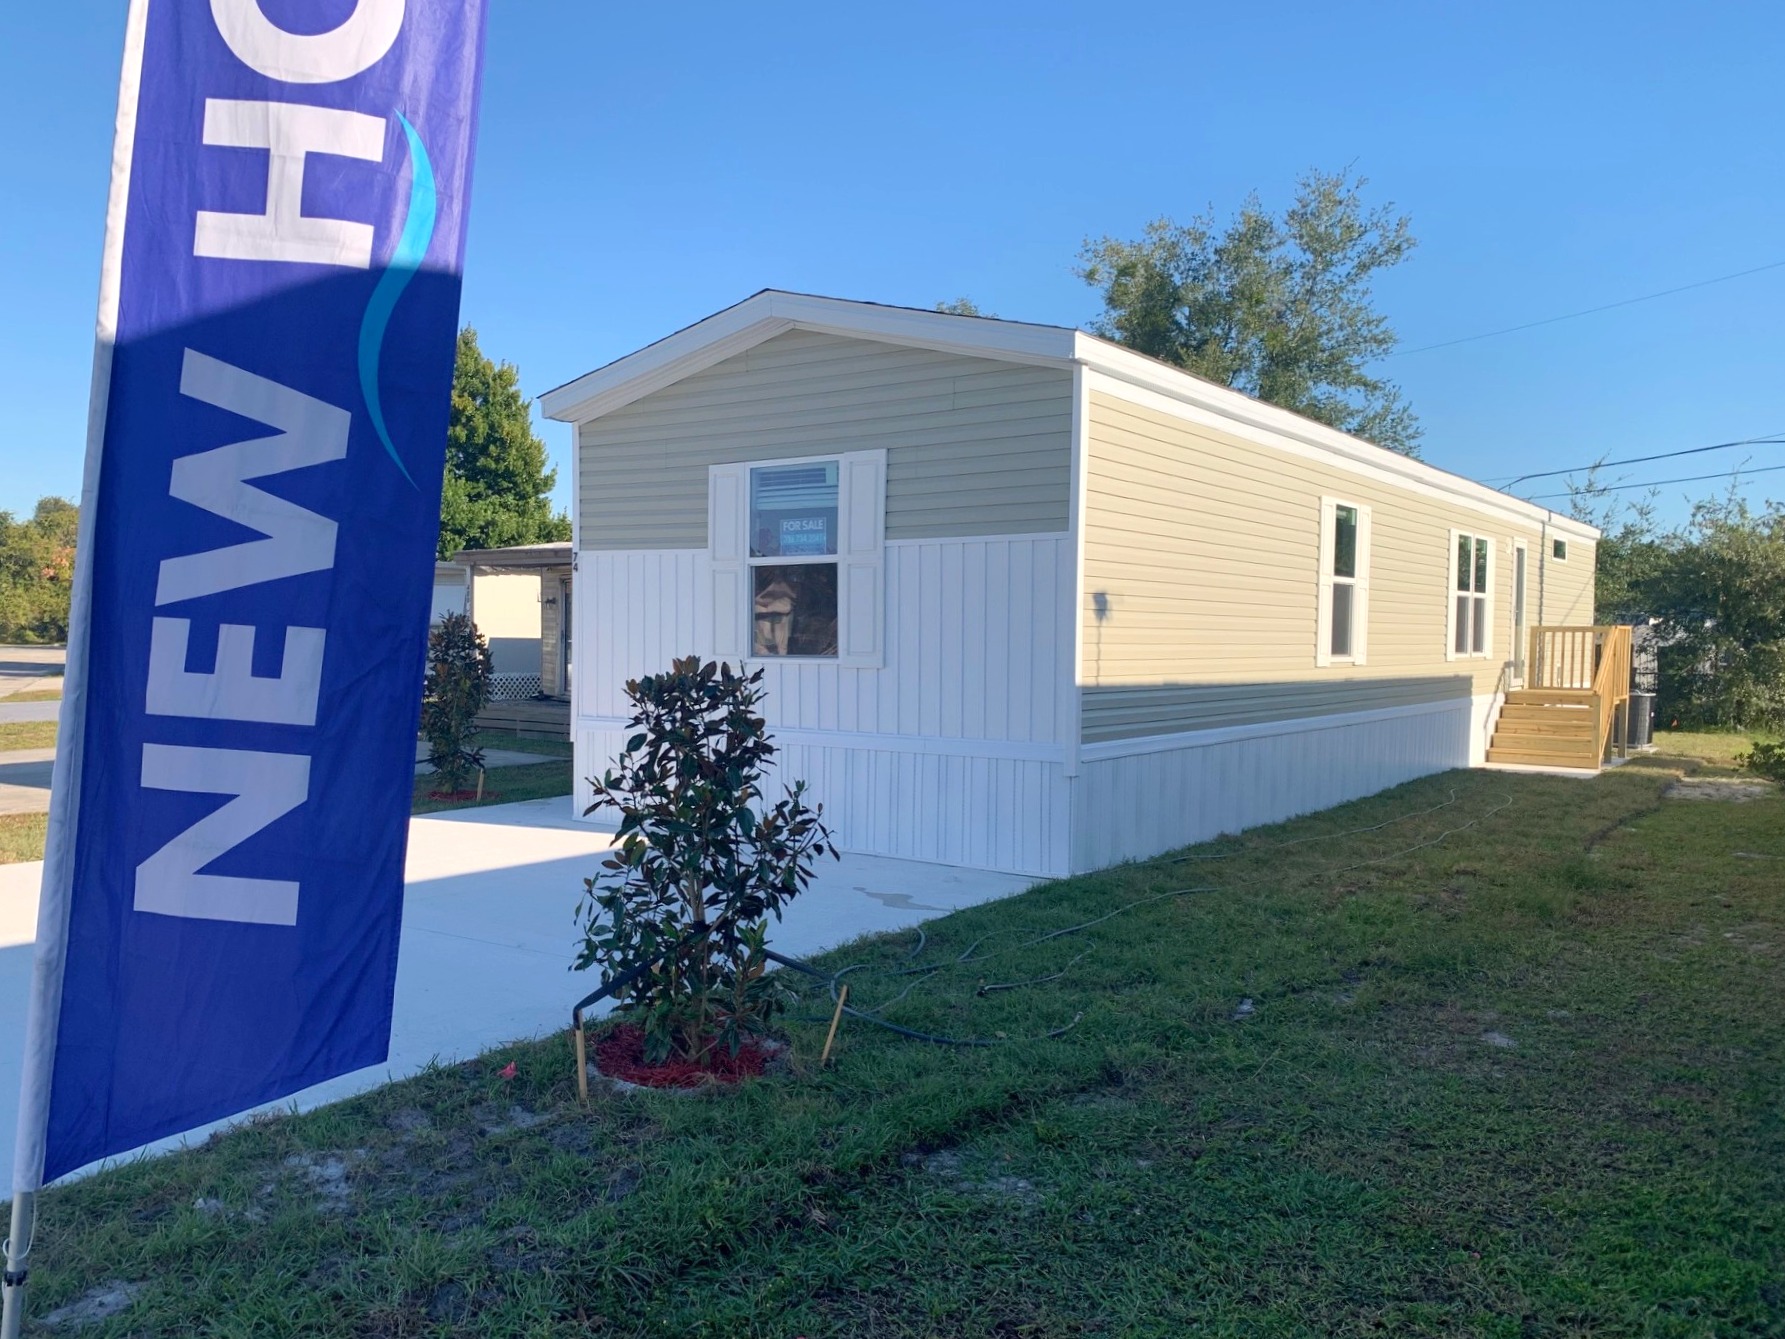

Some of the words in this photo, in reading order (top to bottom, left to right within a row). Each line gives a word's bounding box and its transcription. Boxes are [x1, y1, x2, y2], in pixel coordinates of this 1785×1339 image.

[134, 347, 352, 926] NEW
[783, 521, 801, 531] FOR
[802, 519, 824, 530] SALE
